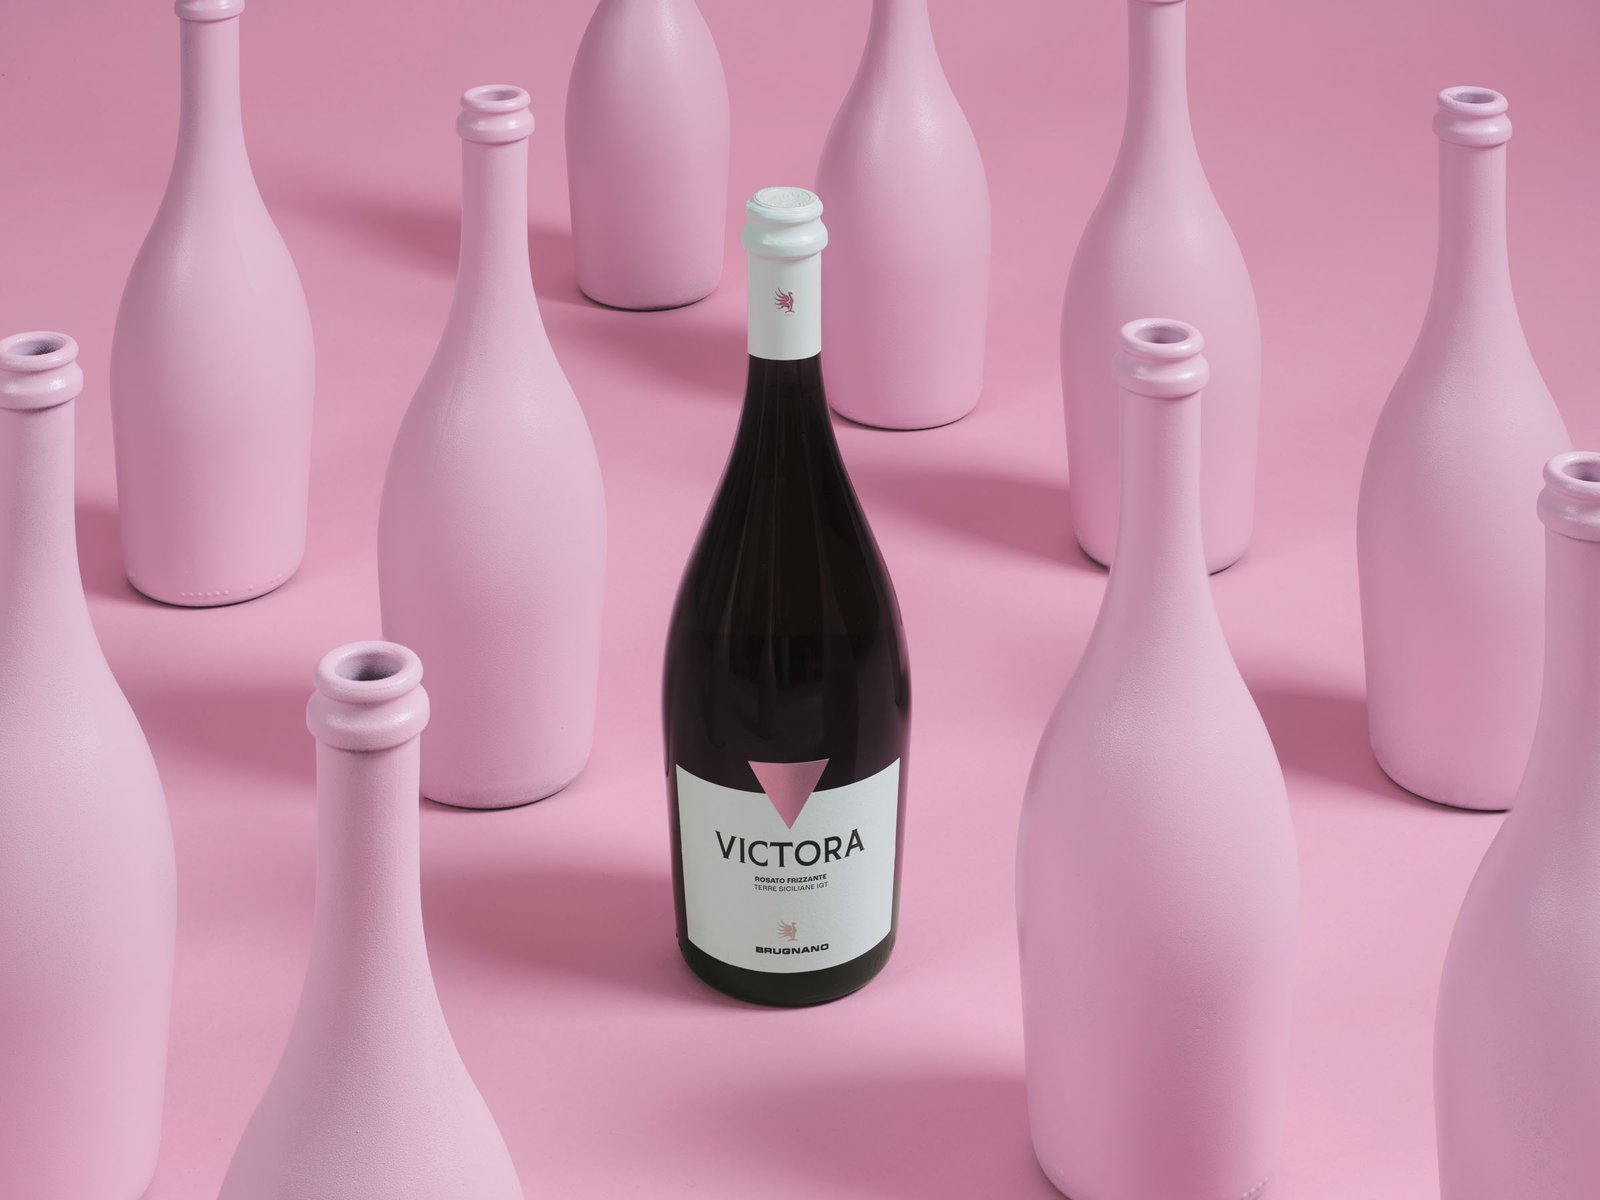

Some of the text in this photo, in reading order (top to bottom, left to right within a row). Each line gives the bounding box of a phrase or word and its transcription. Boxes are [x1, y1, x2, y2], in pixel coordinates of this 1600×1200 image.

[715, 828, 865, 868] VICTORA
[754, 873, 828, 884] ROSATO FRIZZANTE
[754, 881, 829, 892] TERRE SICILIANE IGT
[755, 943, 829, 955] BRUGNANO
